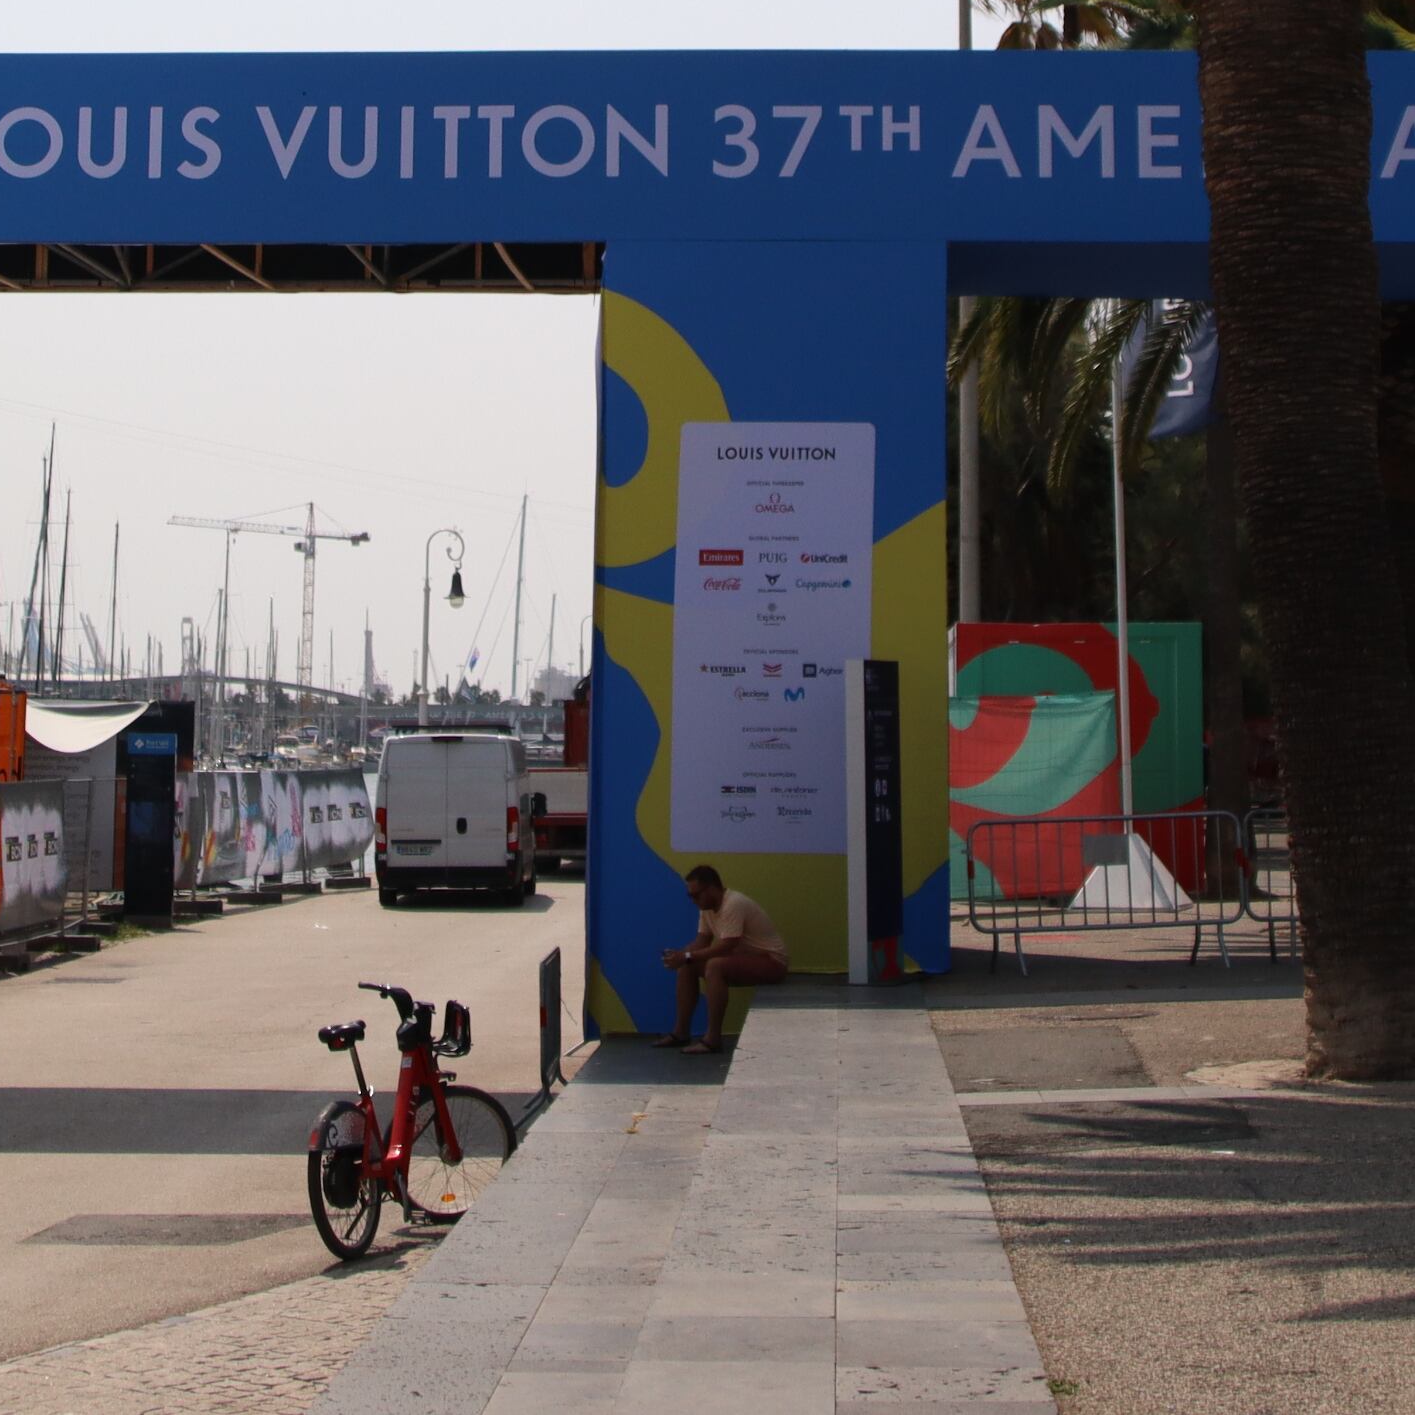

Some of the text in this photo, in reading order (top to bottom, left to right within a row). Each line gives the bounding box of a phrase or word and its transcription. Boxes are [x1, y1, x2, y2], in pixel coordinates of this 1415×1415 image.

[256, 104, 669, 180] VUITTON
[712, 104, 921, 178] 37TH
[717, 447, 836, 460] LOUIS VUITTON
[755, 504, 795, 513] OMEGA
[703, 552, 848, 564] Emirates PUIG UniCredit
